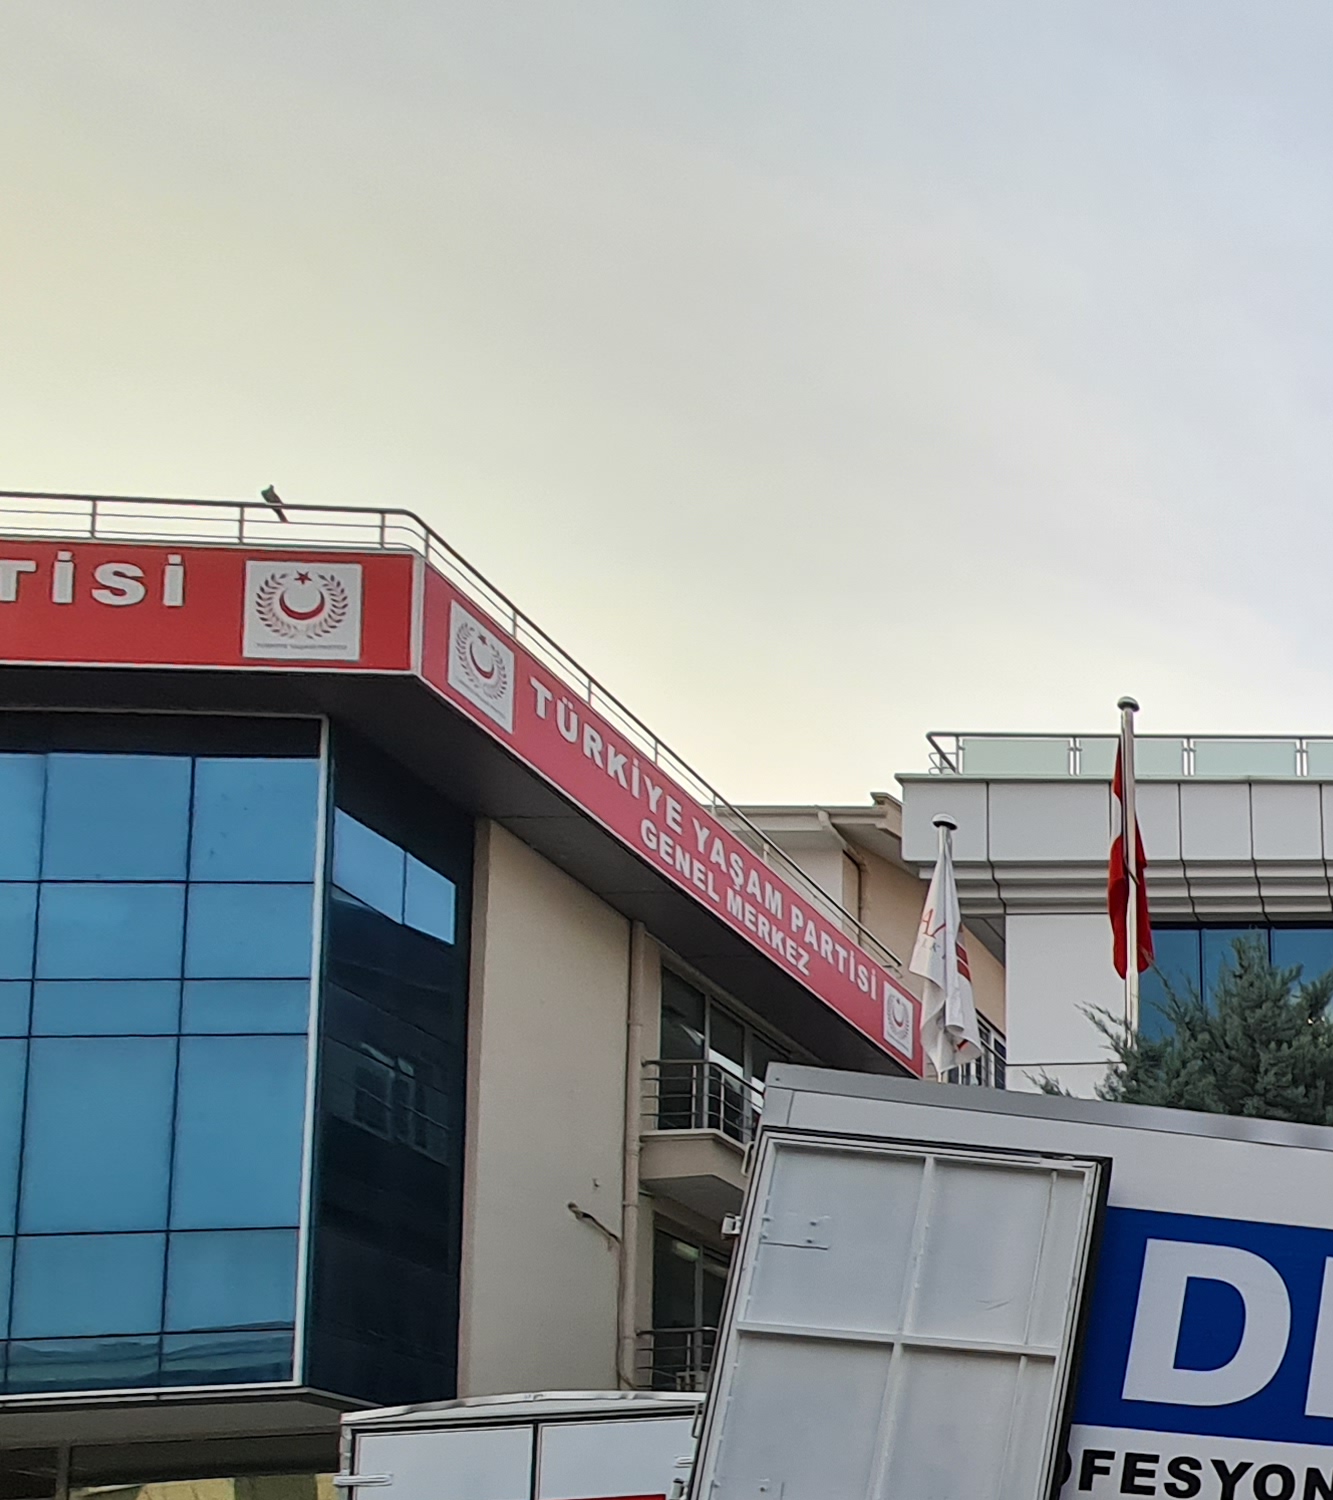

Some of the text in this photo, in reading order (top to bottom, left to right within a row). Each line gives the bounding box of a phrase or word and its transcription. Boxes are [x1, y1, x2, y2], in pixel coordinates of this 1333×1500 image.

[0, 550, 186, 607] TİSİ
[529, 676, 683, 836] TÜRKİYE
[692, 816, 784, 920] YAŞAM
[791, 904, 878, 1001] PARTİSİ
[640, 818, 811, 977] GENEL MERKEZ
